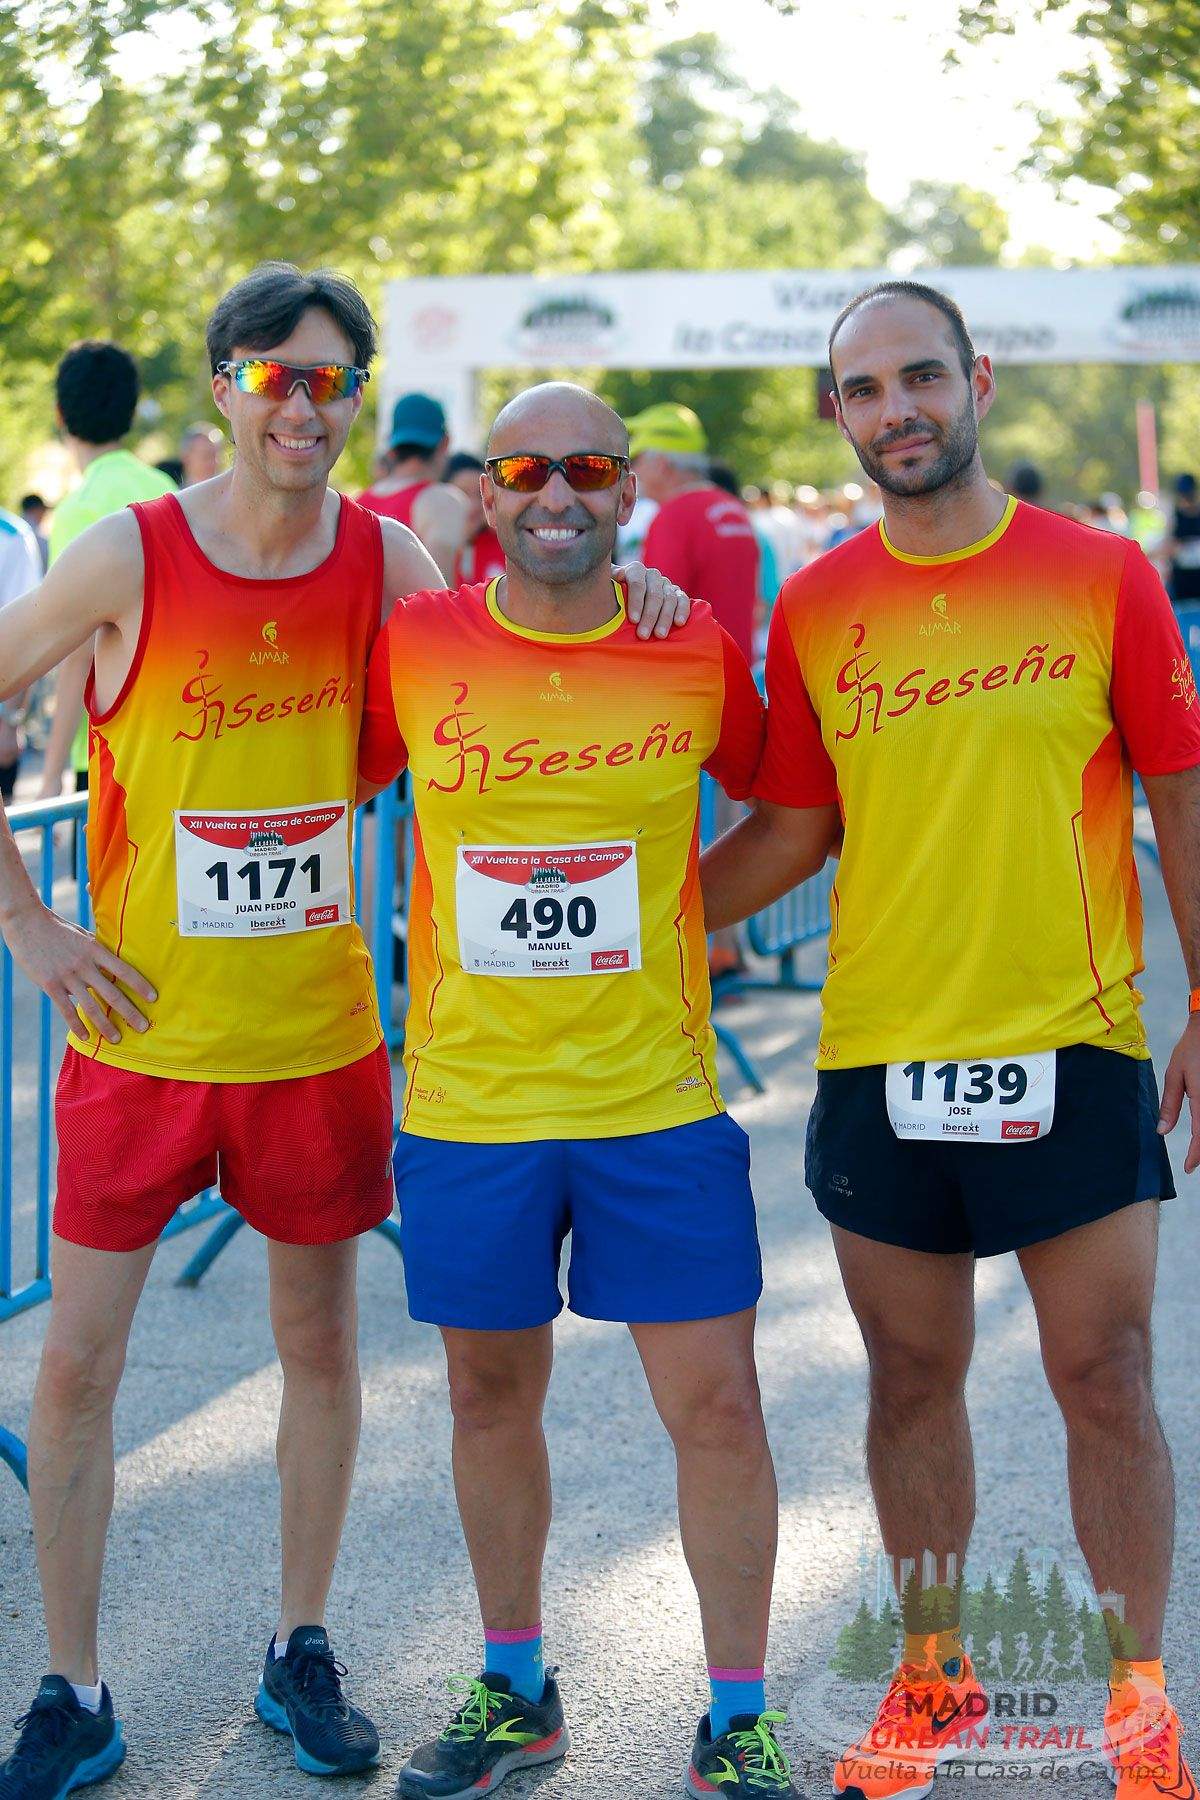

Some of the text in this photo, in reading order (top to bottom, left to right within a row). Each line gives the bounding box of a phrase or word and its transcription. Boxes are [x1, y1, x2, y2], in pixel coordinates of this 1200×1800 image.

[886, 644, 1077, 718] Seseña
[227, 676, 354, 729] Seseña
[495, 721, 693, 782] Seseña
[189, 812, 337, 830] XII Vuelta a la Casa de Campo
[470, 856, 483, 864] XII
[486, 855, 519, 865] Vuelta
[530, 856, 540, 865] la
[545, 855, 571, 864] Casa
[573, 854, 586, 863] de
[588, 851, 625, 863] Campo
[205, 853, 321, 901] 1171
[235, 900, 297, 915] JUAN PEDRO
[250, 917, 286, 929] Iberext
[500, 895, 597, 940] 490
[202, 921, 234, 929] MADRID
[527, 942, 573, 951] MANUEL
[483, 960, 516, 968] MADRID
[531, 957, 570, 968] Iberext
[902, 1060, 1028, 1105] 1139
[947, 1106, 972, 1117] JOSE
[899, 1123, 926, 1131] MADRID
[941, 1122, 980, 1133] Iberext
